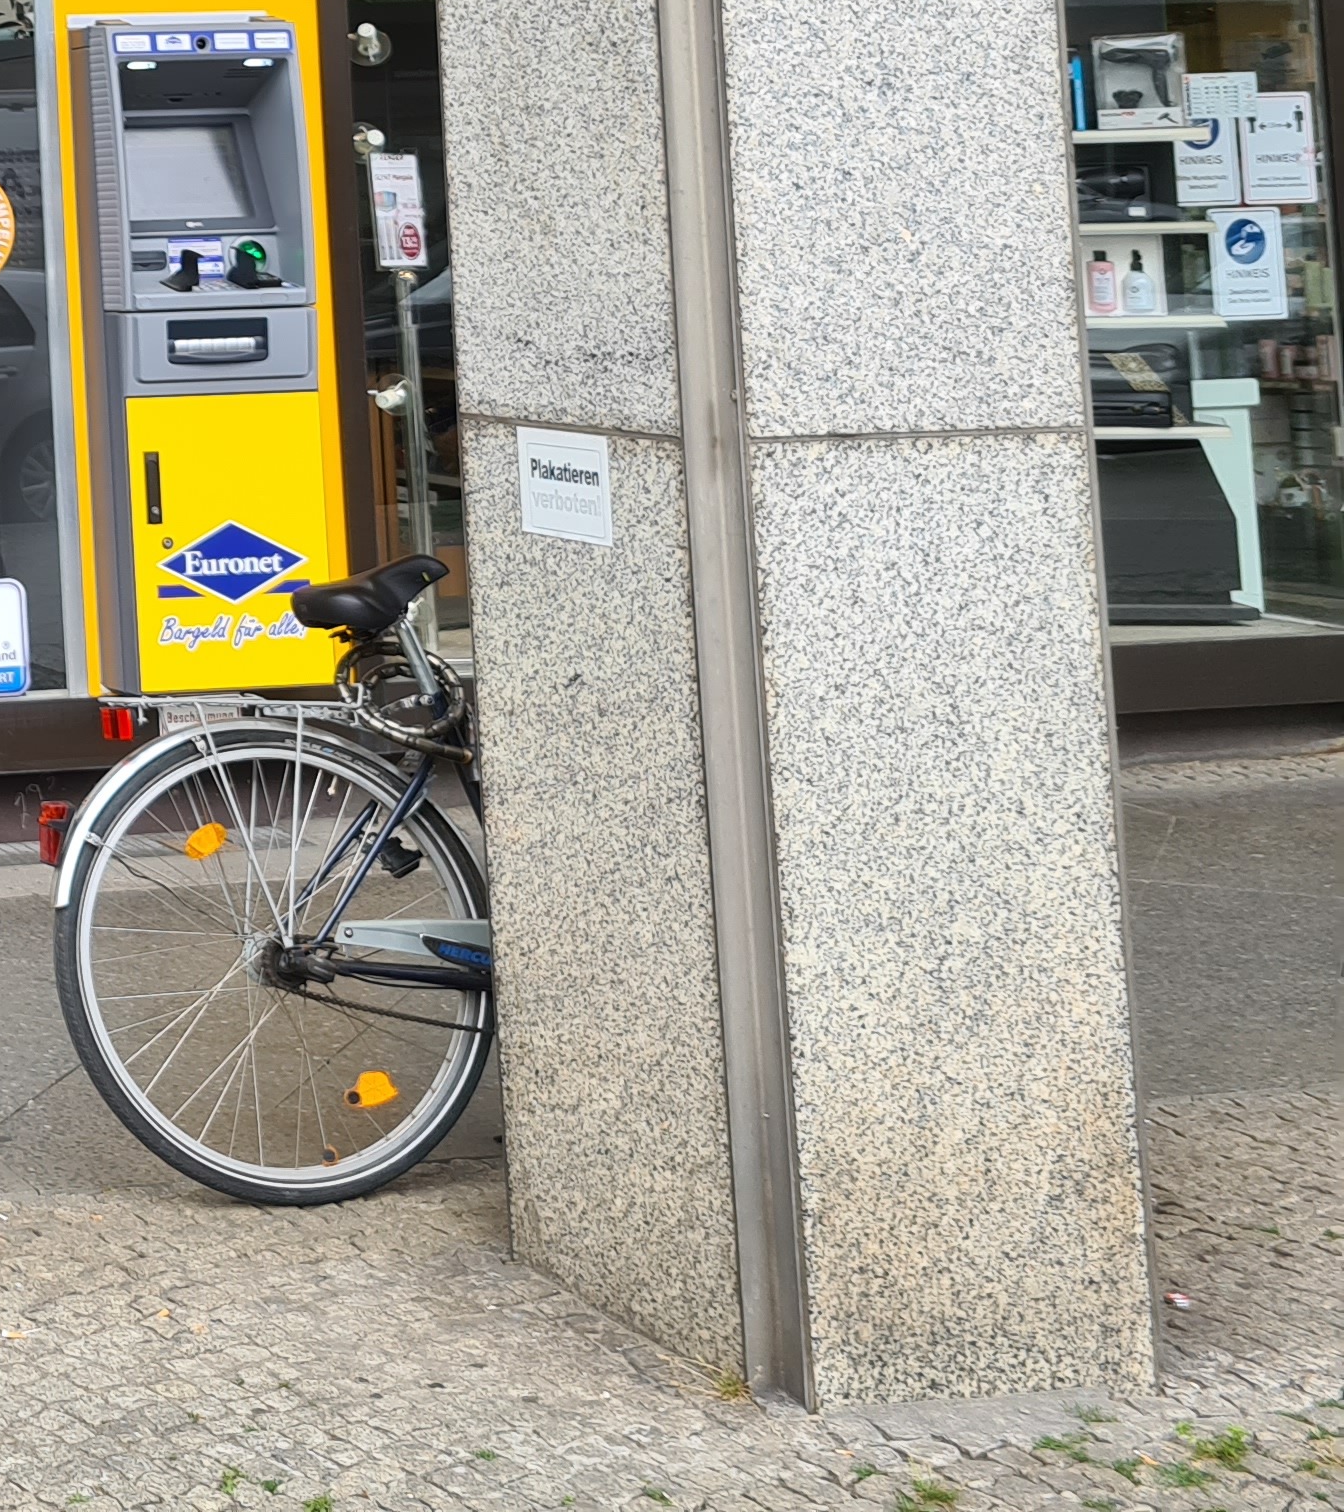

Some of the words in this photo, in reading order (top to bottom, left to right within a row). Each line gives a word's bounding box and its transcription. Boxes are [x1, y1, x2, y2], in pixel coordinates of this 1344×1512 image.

[529, 457, 600, 488] Plakatieren
[531, 489, 603, 518] verboten!
[181, 549, 283, 578] Euronet
[160, 617, 228, 650] Bargeld
[233, 616, 264, 650] für
